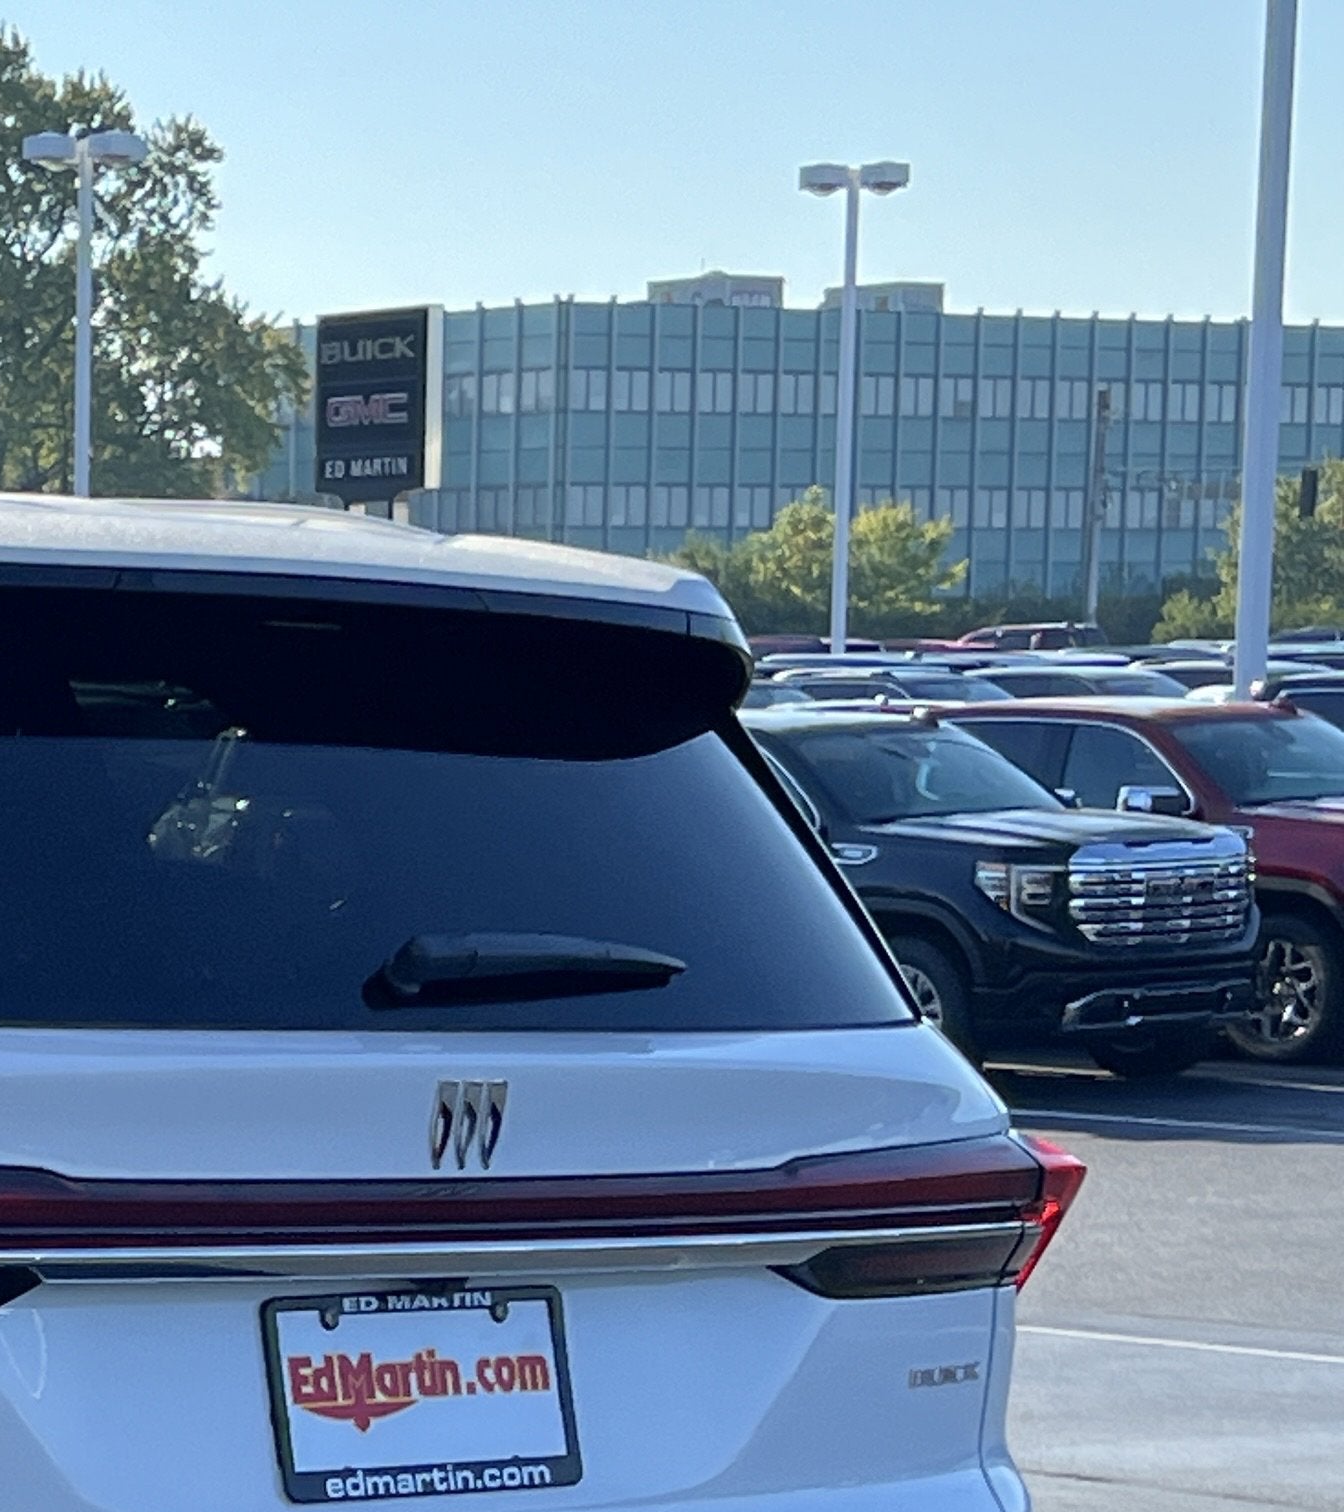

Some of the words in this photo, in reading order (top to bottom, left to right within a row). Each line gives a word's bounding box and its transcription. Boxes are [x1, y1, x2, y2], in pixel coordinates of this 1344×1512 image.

[320, 334, 415, 364] BUICK
[326, 392, 409, 427] GMC
[325, 460, 345, 479] ED
[350, 456, 408, 478] MARTIN
[341, 1297, 379, 1312] ED
[287, 1348, 551, 1404] EdMartin.com
[325, 1461, 551, 1498] edmartin.com
